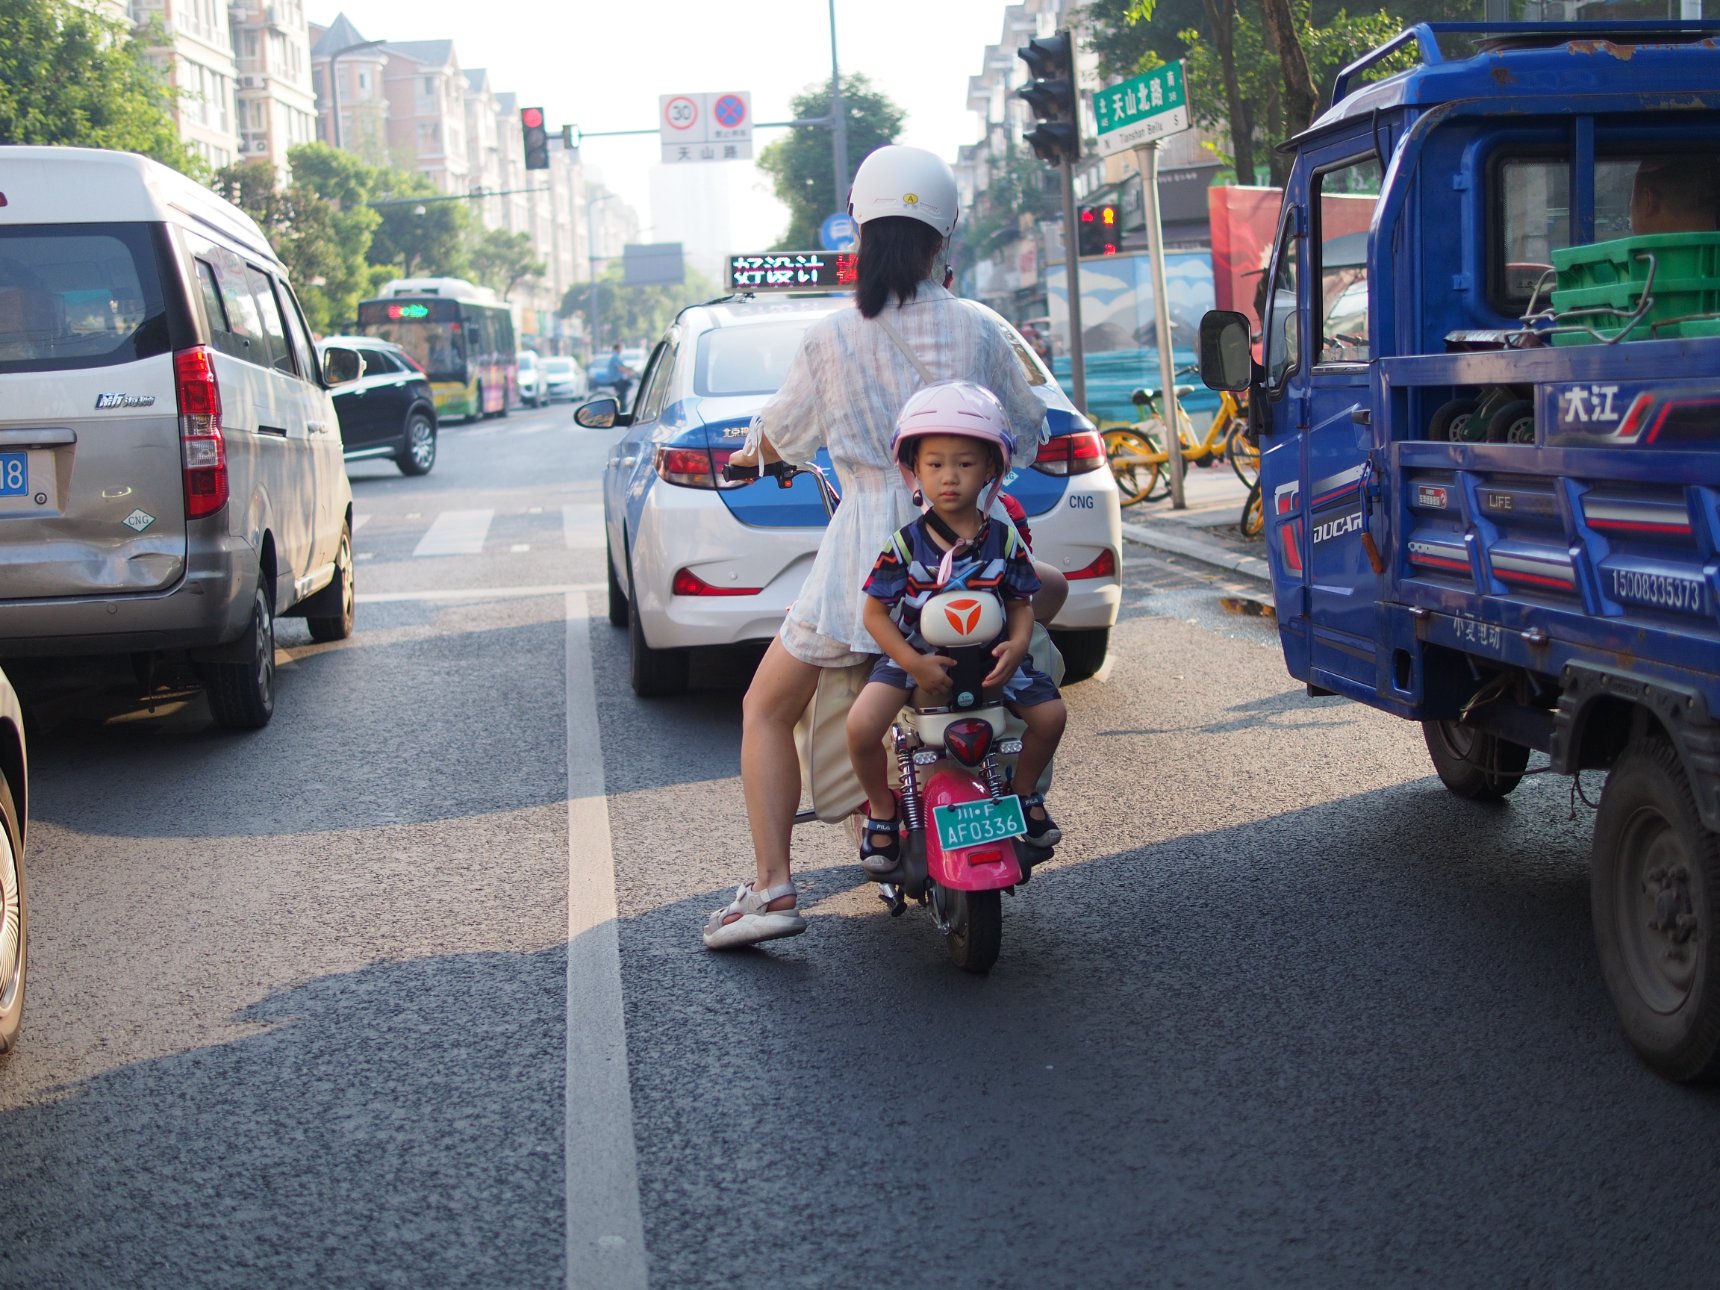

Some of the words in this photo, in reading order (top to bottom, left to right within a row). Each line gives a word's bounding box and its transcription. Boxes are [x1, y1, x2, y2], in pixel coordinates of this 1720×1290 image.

[672, 104, 692, 121] 30
[1112, 77, 1164, 121] 天山北路
[733, 254, 824, 285] 好设计
[1565, 385, 1618, 422] 大江
[1069, 495, 1094, 509] CNG
[1489, 494, 1512, 509] LIFE
[128, 515, 149, 527] CNG
[1612, 569, 1699, 610] 15008335373
[948, 815, 1018, 845] AF0336
